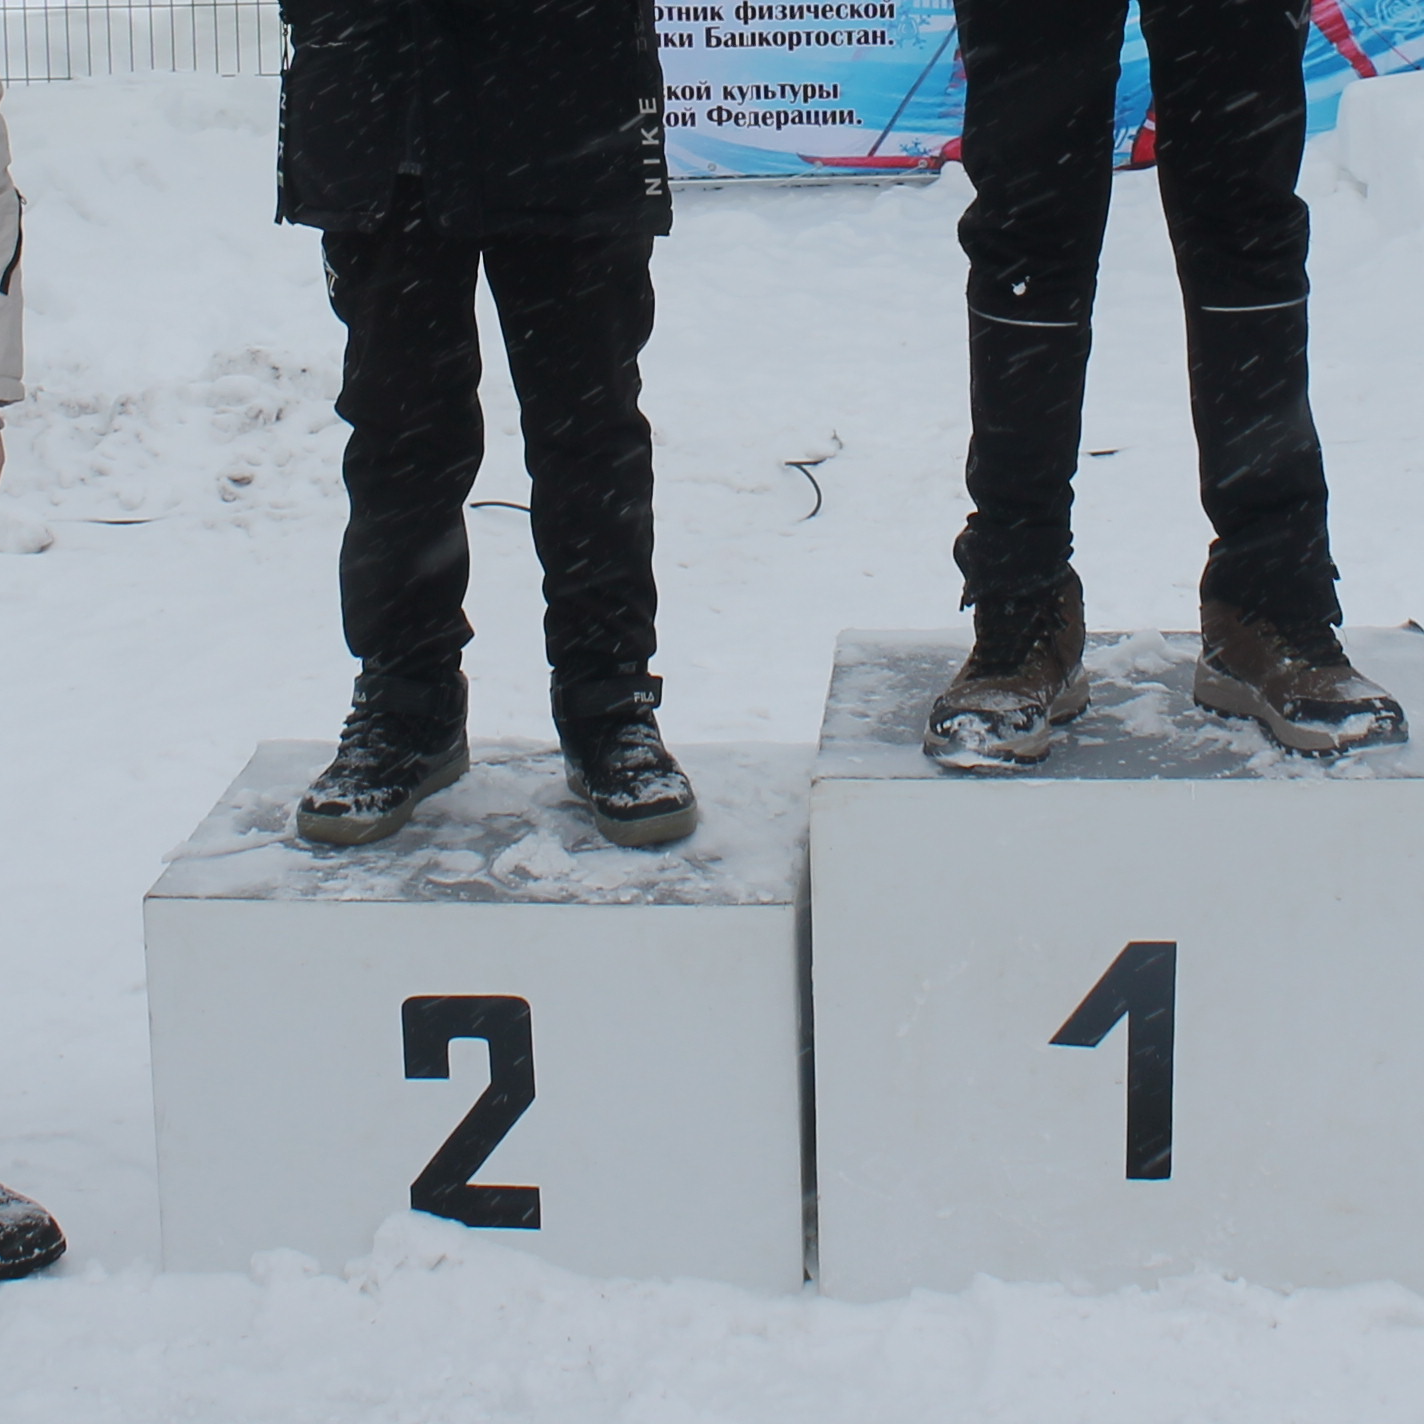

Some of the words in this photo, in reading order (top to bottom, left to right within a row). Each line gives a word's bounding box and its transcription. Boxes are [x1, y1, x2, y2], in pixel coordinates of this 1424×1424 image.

[734, 0, 895, 24] физической
[705, 26, 895, 51] Башкортостан.
[723, 81, 839, 105] культуры
[707, 105, 863, 129] Федерации.
[639, 97, 663, 196] NIKE
[633, 691, 655, 703] FILA
[1049, 941, 1177, 1180] 1
[402, 995, 541, 1229] 2
